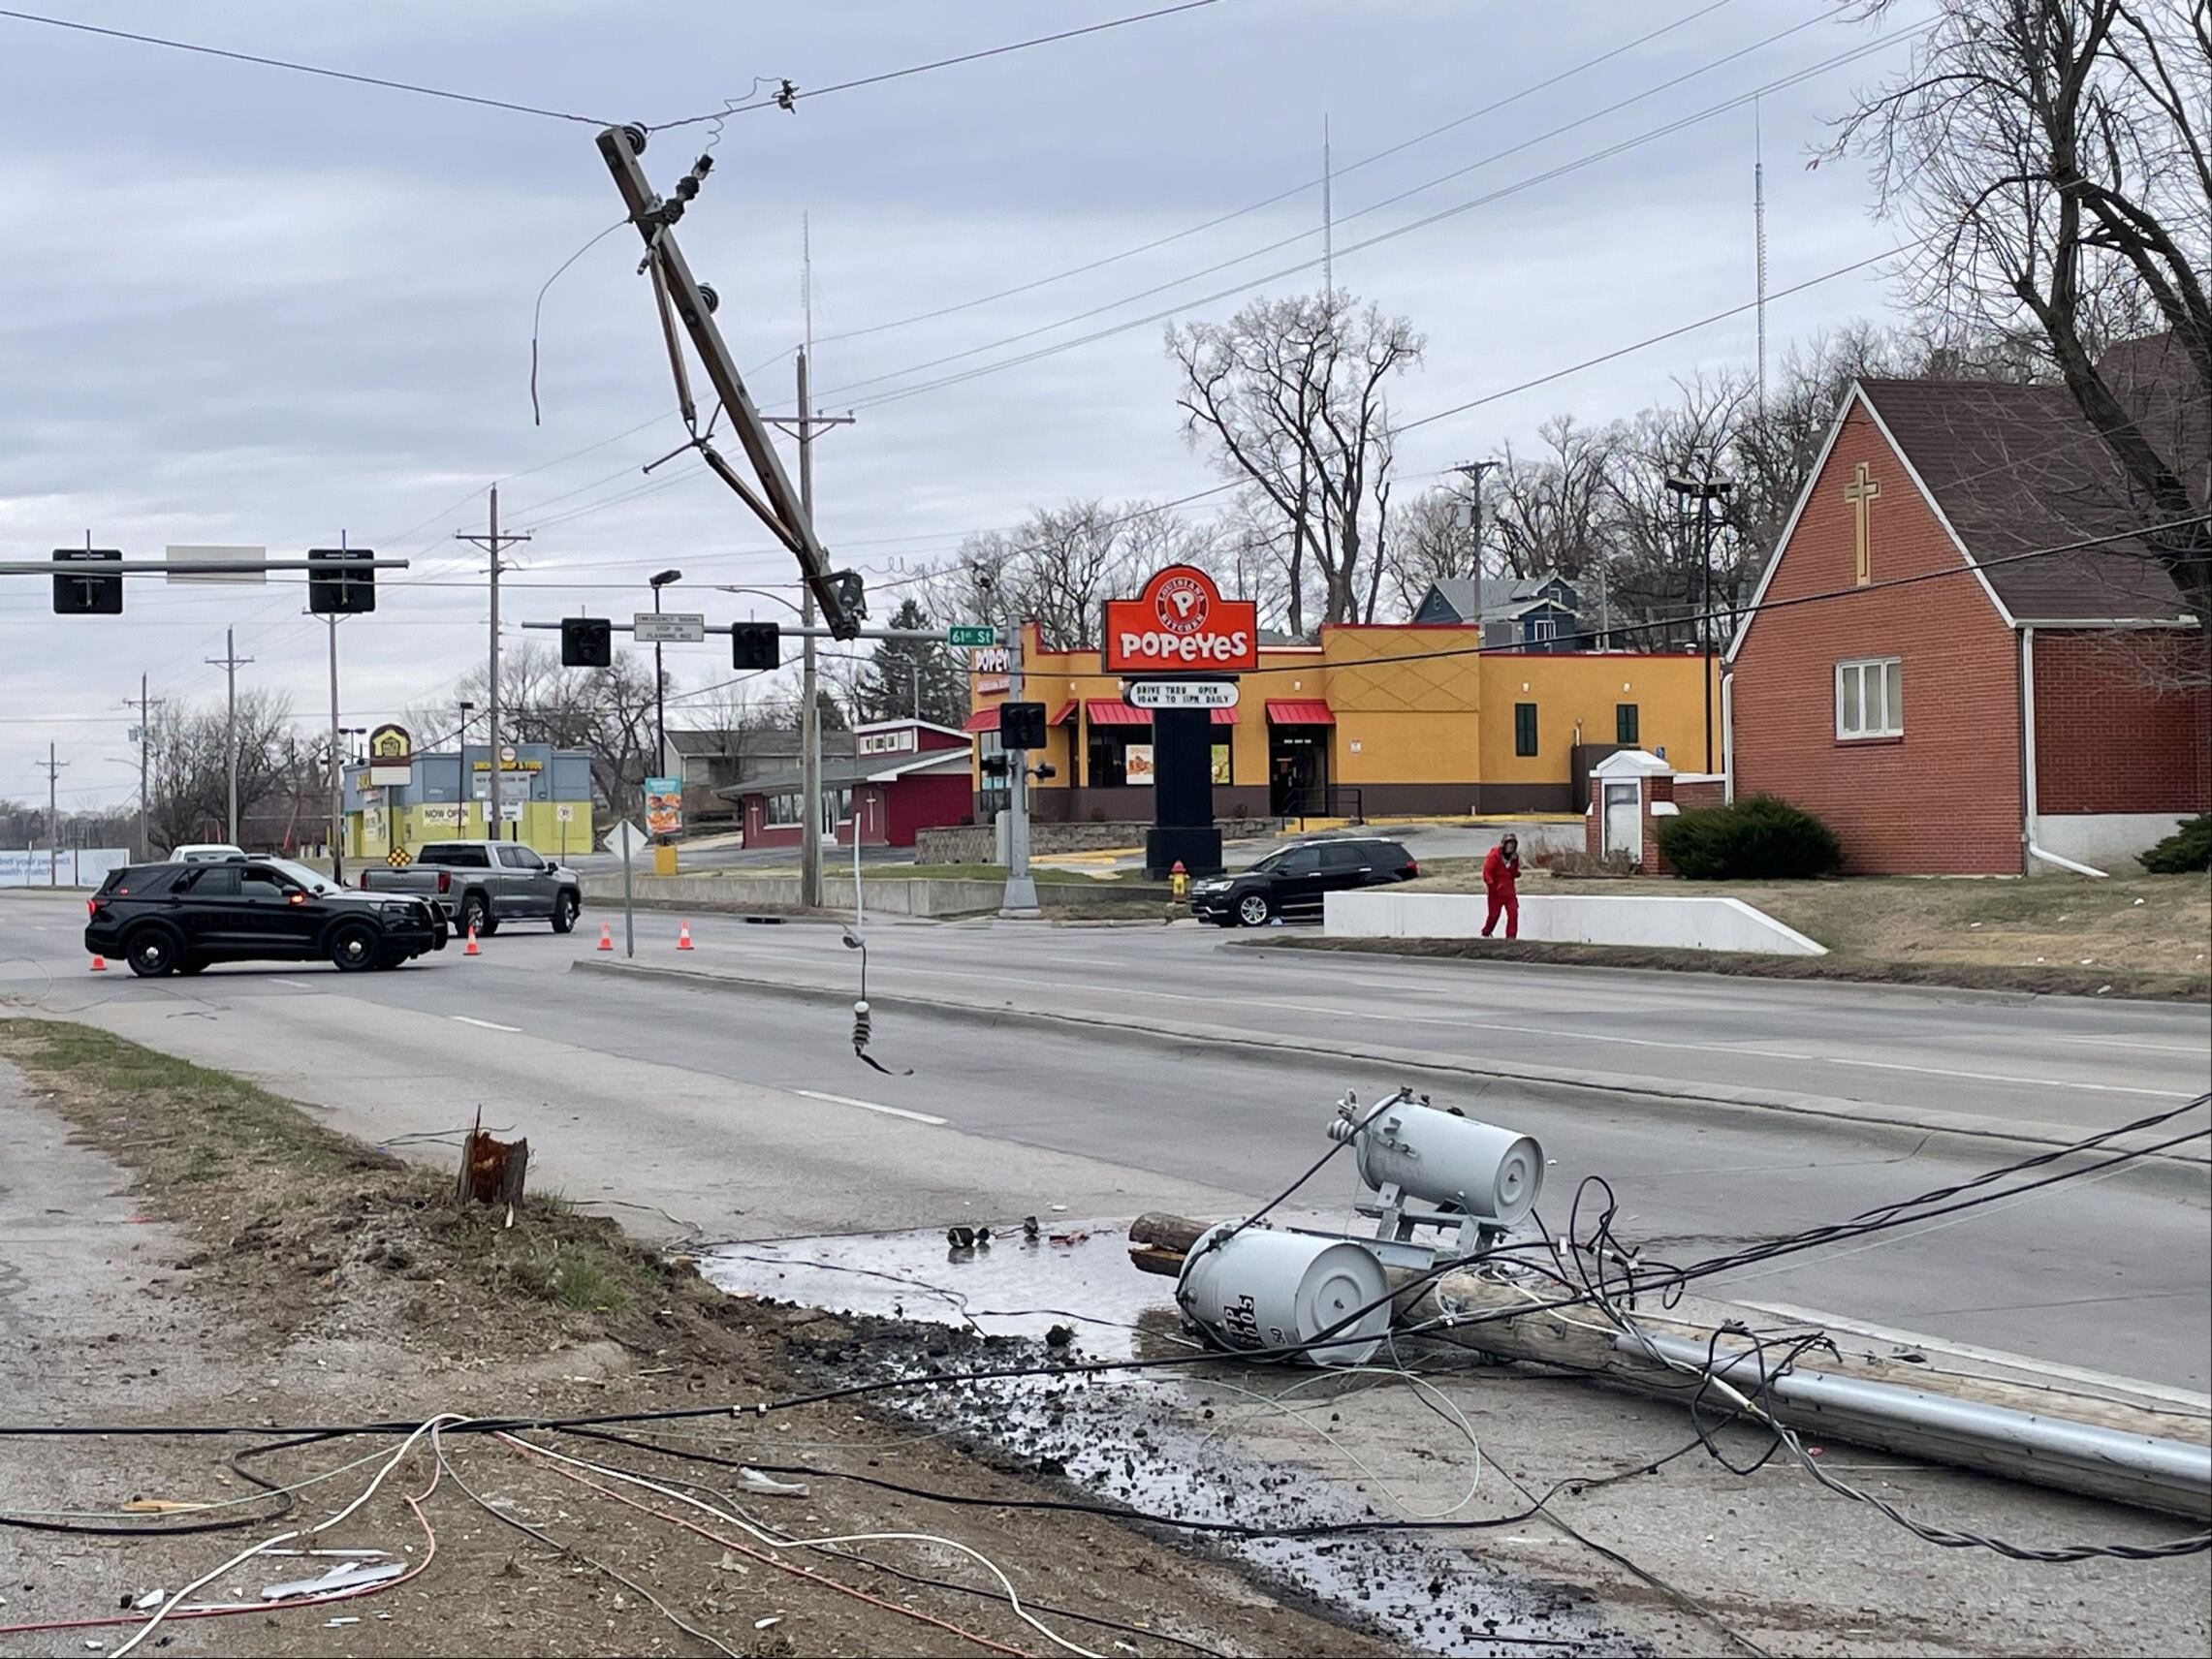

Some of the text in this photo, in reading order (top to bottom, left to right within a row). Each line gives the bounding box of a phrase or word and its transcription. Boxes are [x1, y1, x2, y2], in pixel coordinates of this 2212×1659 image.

[1171, 590, 1195, 617] P
[977, 630, 992, 643] St
[1136, 686, 1160, 695] DRIVE
[1165, 686, 1186, 695] THRU
[425, 809, 468, 818] NOW OPN
